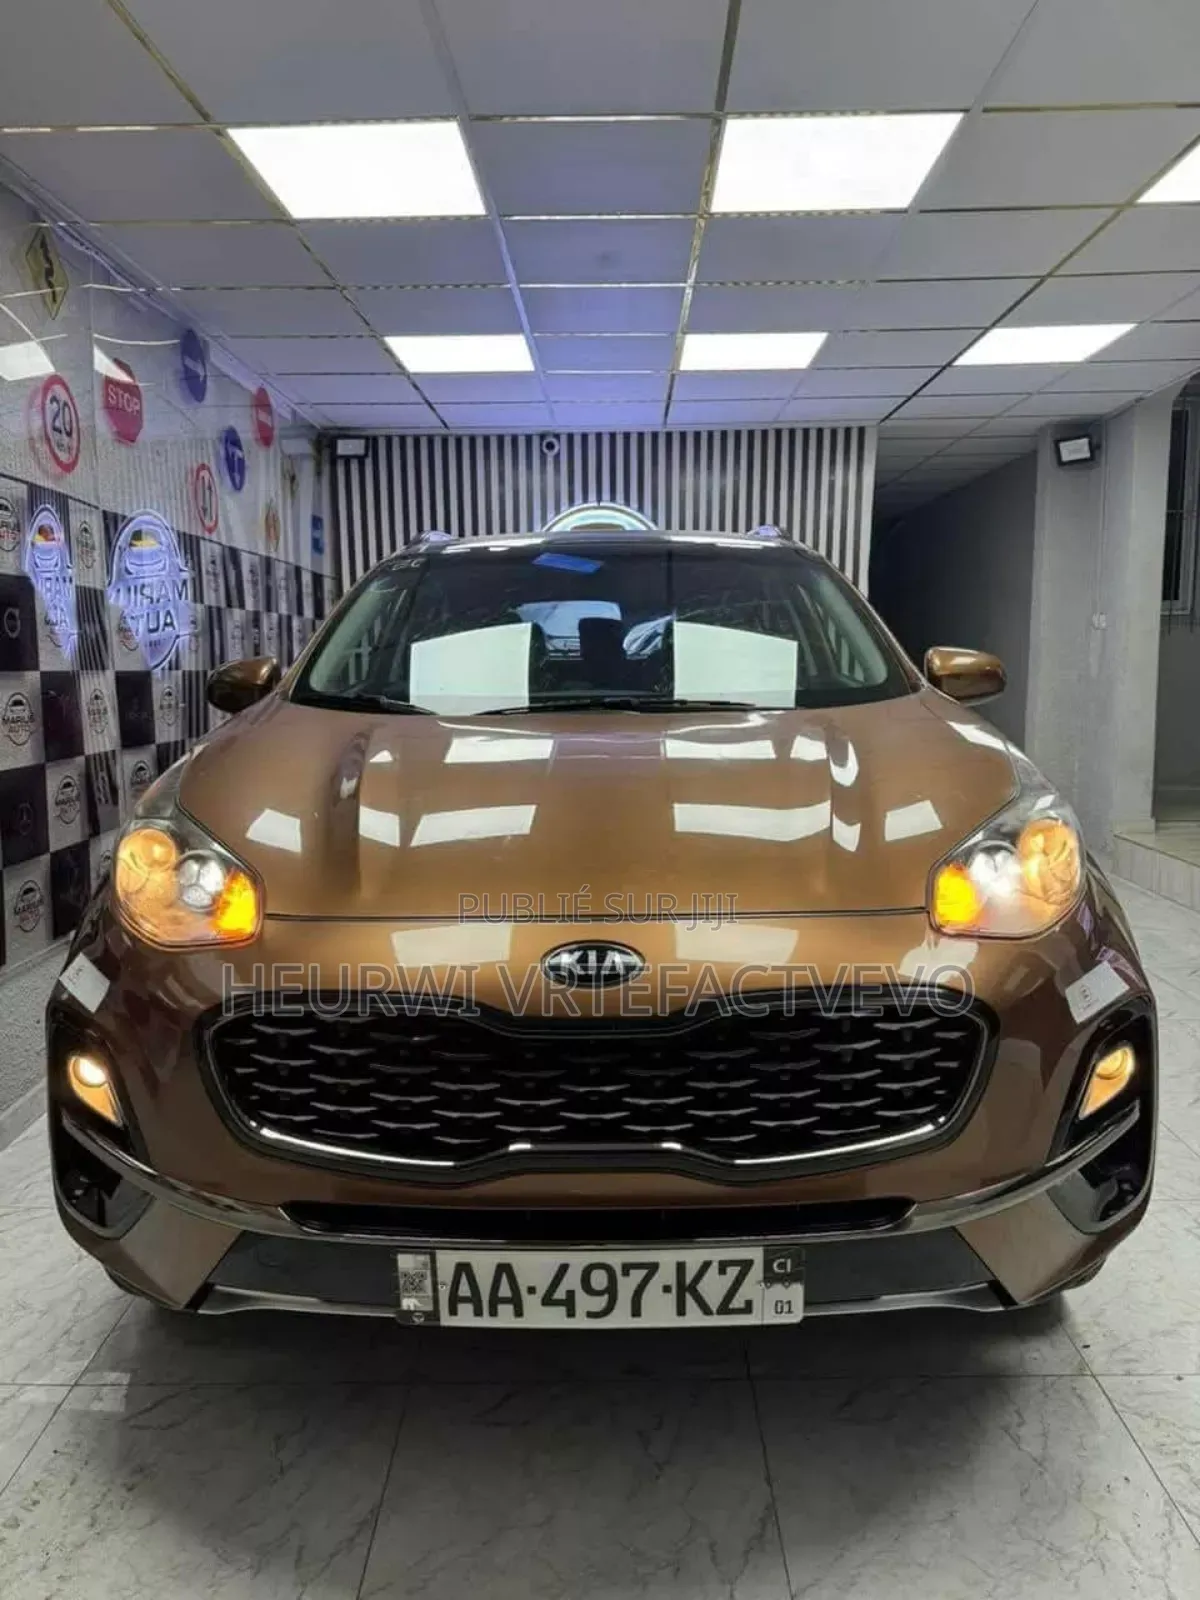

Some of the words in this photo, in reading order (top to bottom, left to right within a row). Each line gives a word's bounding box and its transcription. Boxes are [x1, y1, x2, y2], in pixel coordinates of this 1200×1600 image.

[107, 384, 141, 415] STOP
[49, 395, 73, 438] 20
[560, 950, 625, 974] KIA
[772, 1258, 792, 1273] CI
[773, 1299, 794, 1315] 01
